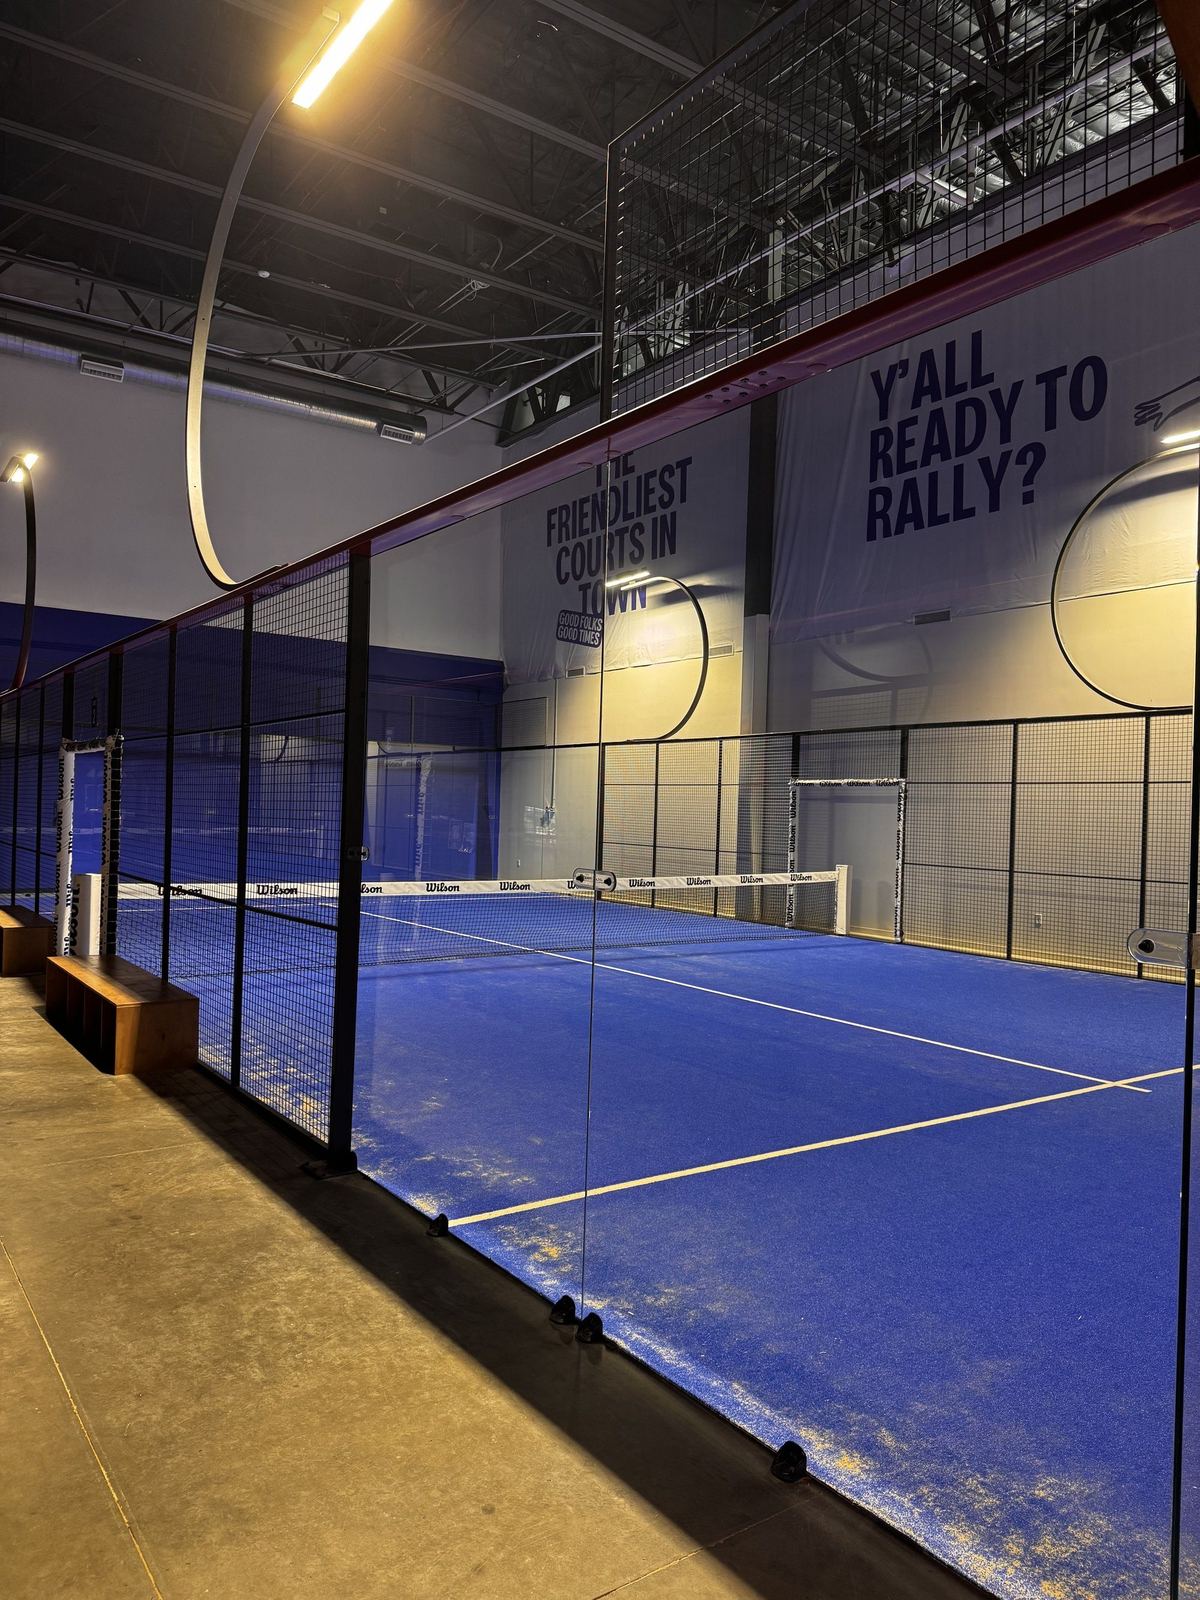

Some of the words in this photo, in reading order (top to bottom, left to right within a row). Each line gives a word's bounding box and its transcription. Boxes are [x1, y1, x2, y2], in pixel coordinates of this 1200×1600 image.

[870, 330, 994, 421] Y'ALL
[869, 379, 1025, 483] READY
[1035, 355, 1108, 432] TO
[546, 456, 693, 547] FRIENDLIEST
[866, 442, 1047, 542] RALLY?
[556, 522, 645, 585] COURTS
[651, 511, 677, 560] IN
[559, 610, 579, 629] GOOD
[579, 612, 603, 632] FOLKS
[579, 567, 648, 617] TOWN
[557, 625, 578, 643] GOOD
[578, 628, 601, 646] TIMES
[256, 884, 298, 896] Wilson
[426, 882, 460, 893] Wilson
[499, 881, 531, 891] Wilson
[629, 878, 656, 888] Wilson
[686, 876, 712, 886] Wilson
[741, 875, 764, 884] Wilson
[790, 873, 813, 882] Wilson
